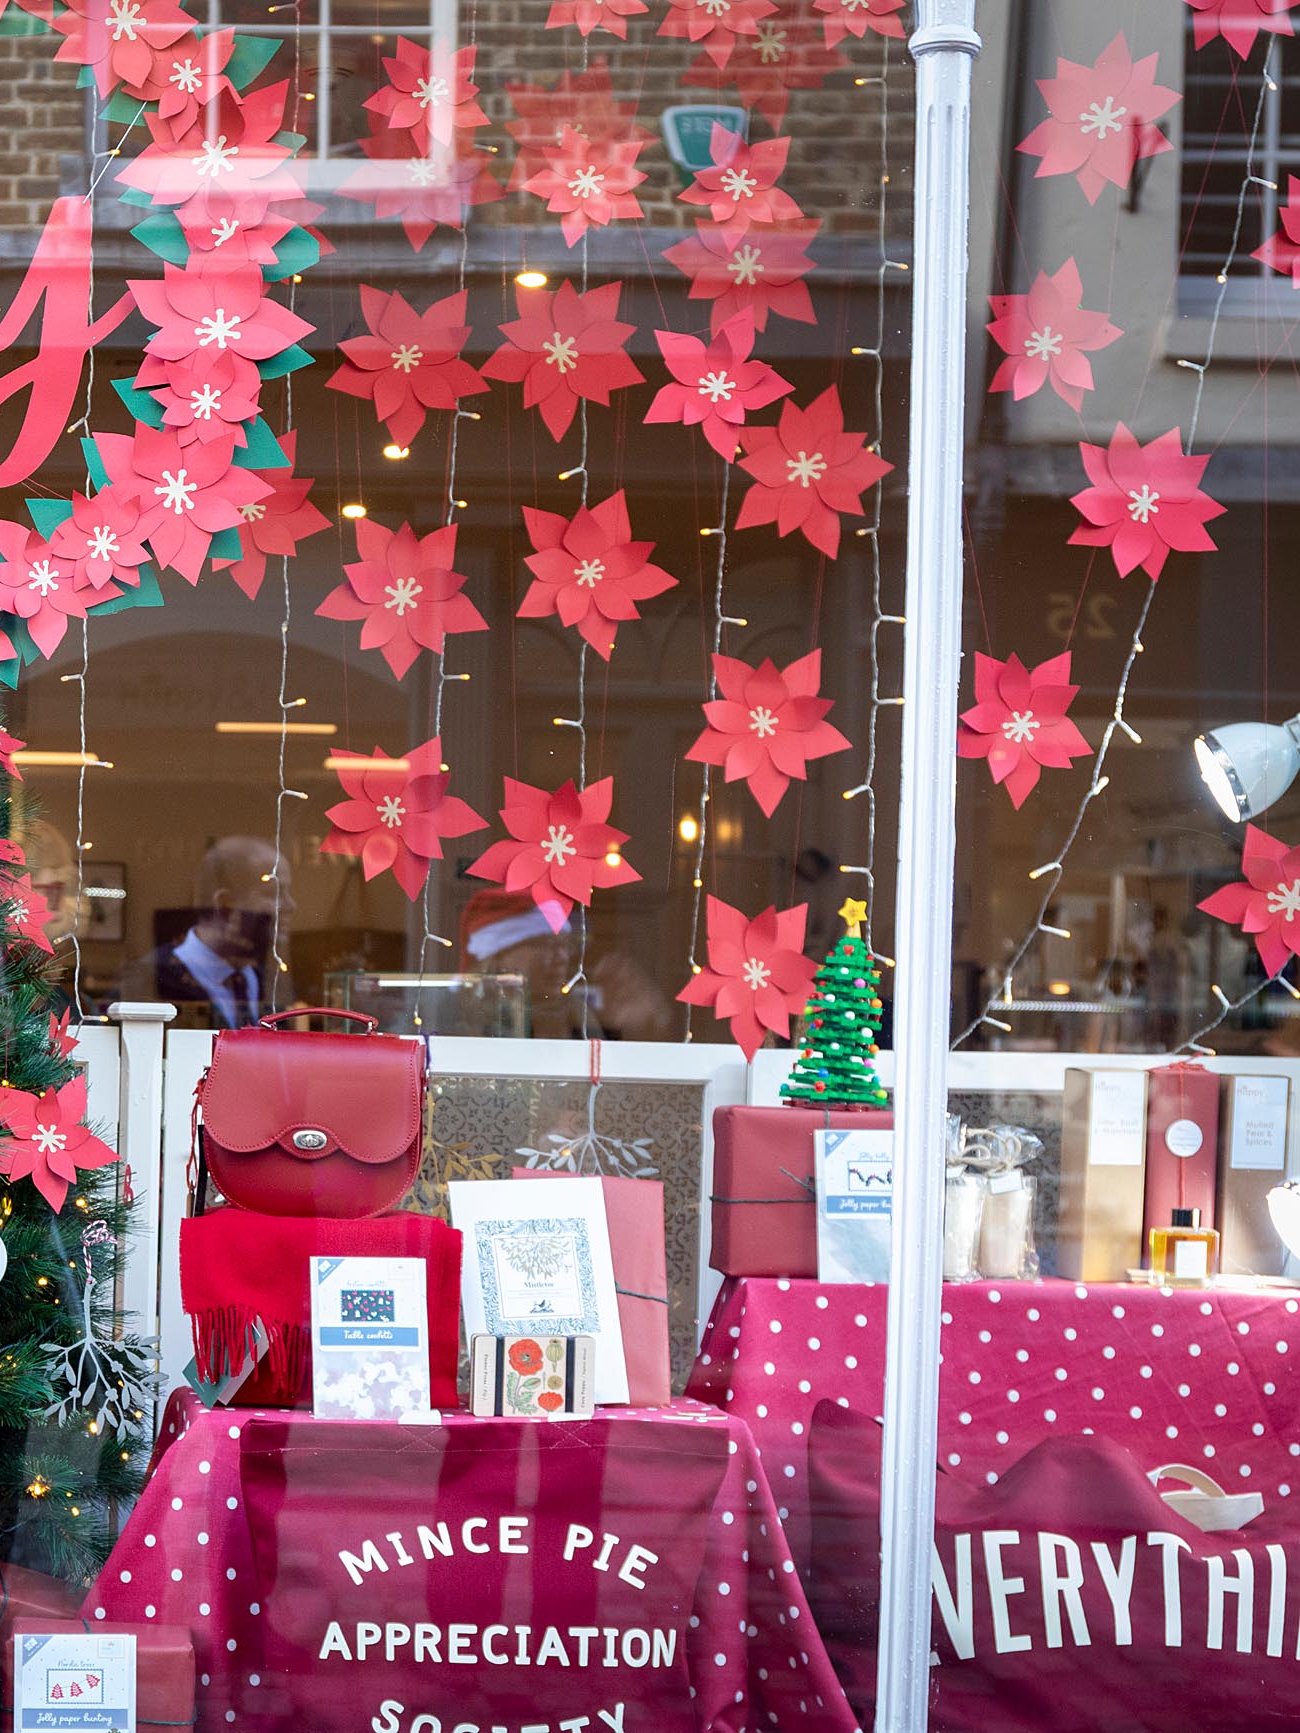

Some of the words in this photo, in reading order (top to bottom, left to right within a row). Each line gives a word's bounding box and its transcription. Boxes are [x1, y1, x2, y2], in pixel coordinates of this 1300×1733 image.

[839, 1198, 859, 1212] Jolly
[343, 1330, 364, 1340] Table
[366, 1330, 393, 1340] confetti
[338, 1516, 530, 1586] MINCE
[563, 1523, 659, 1591] PIE
[318, 1620, 677, 1669] APPRECIATION
[36, 1712, 58, 1727] Jolly
[59, 1716, 81, 1726] paper
[83, 1712, 113, 1727] bunting
